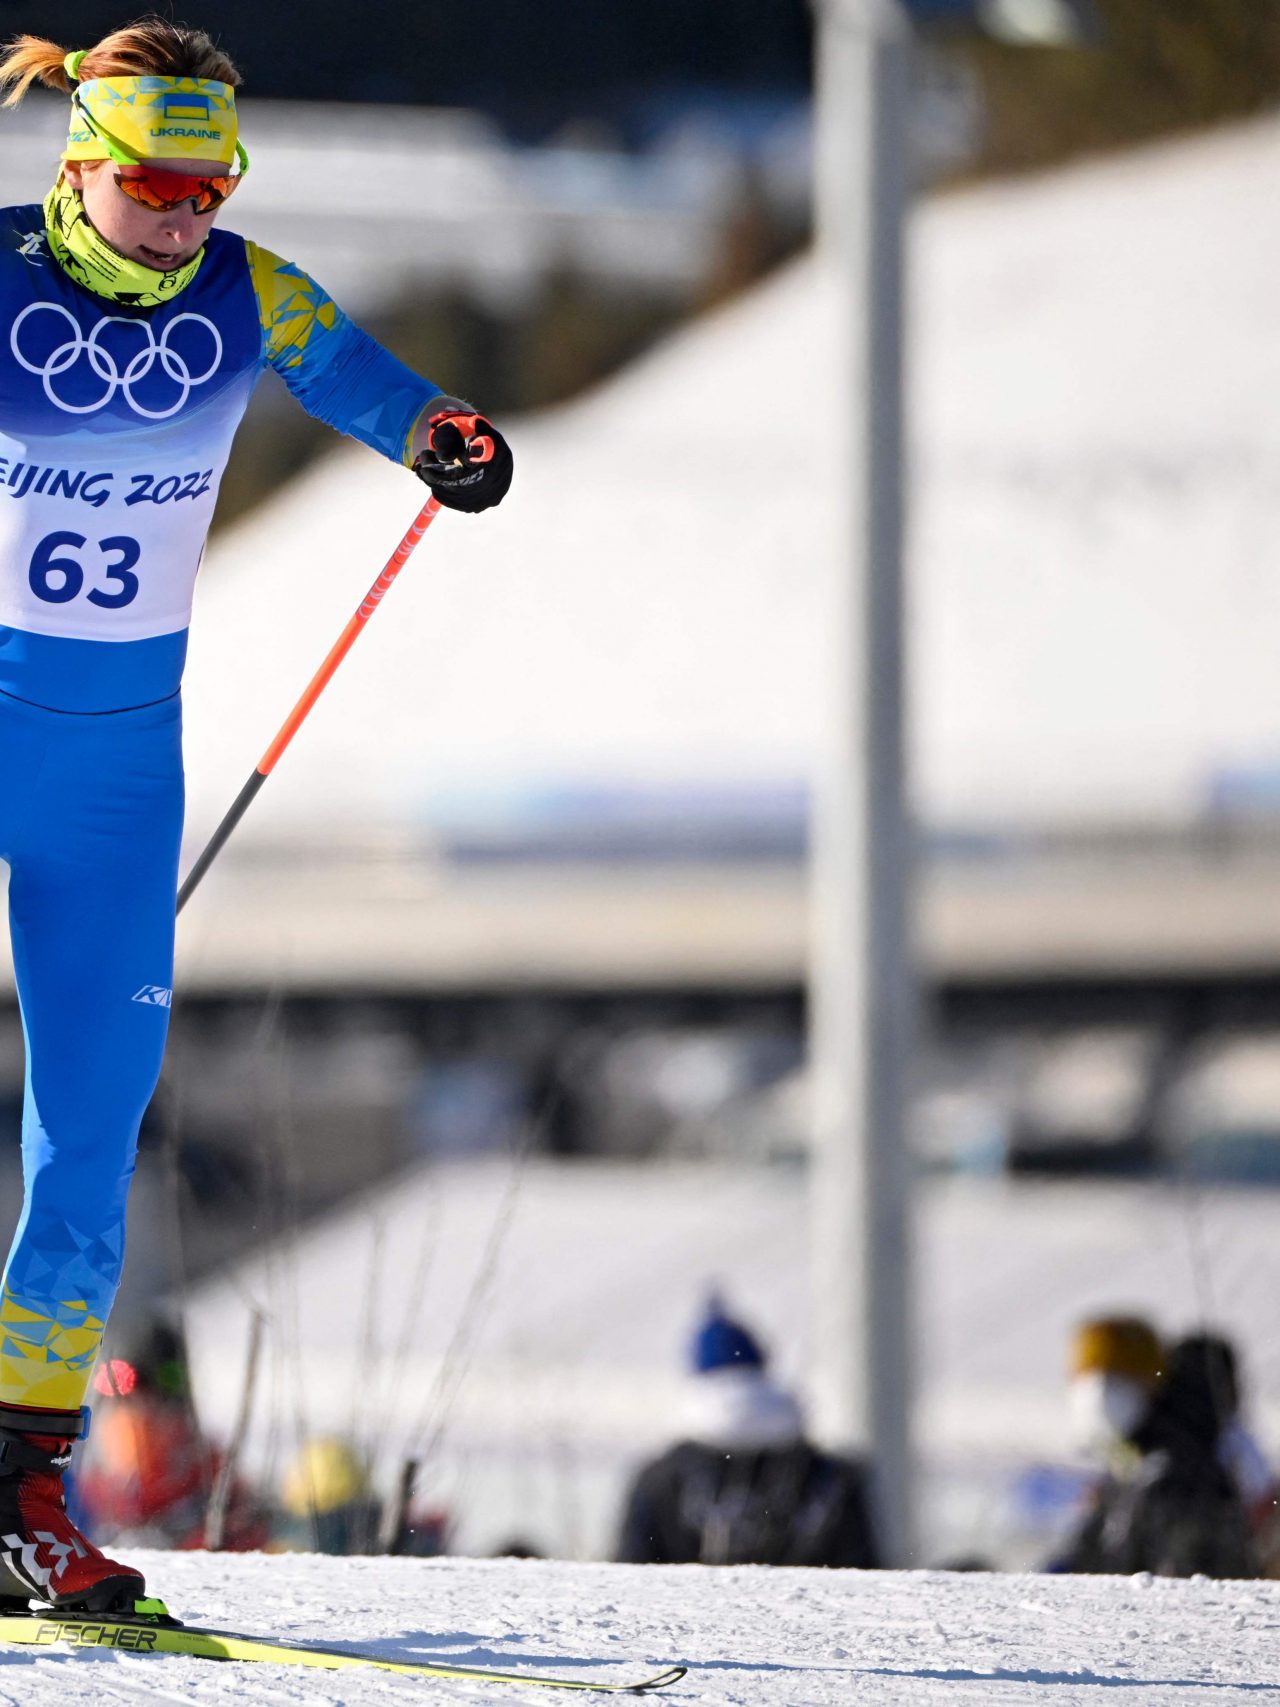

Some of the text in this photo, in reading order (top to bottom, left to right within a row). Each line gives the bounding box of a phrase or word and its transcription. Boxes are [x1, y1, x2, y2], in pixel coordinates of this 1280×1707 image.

[150, 127, 222, 141] UKRAINE
[124, 468, 214, 507] 2022
[28, 530, 141, 609] 63
[35, 1623, 158, 1650] FISCHER
